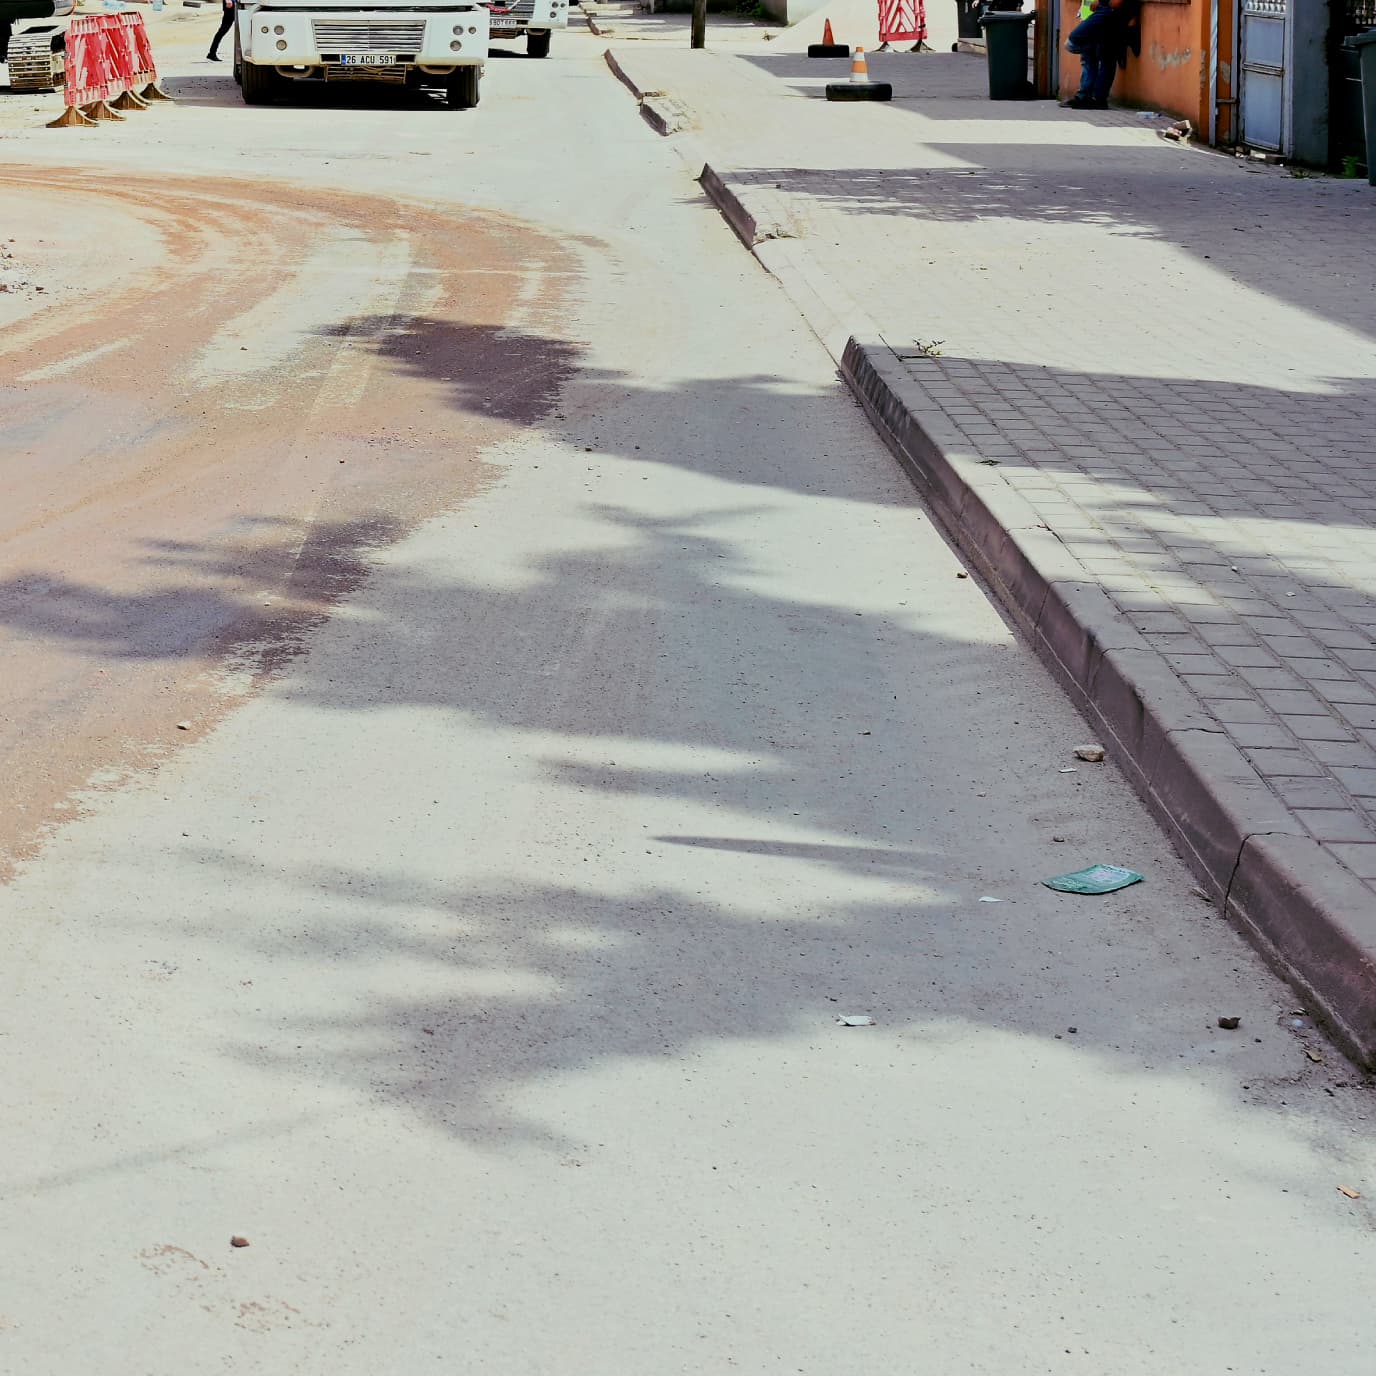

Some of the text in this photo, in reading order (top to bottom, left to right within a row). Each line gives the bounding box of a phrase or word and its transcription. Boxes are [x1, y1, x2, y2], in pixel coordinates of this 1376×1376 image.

[346, 55, 393, 64] 26 ACU 591
